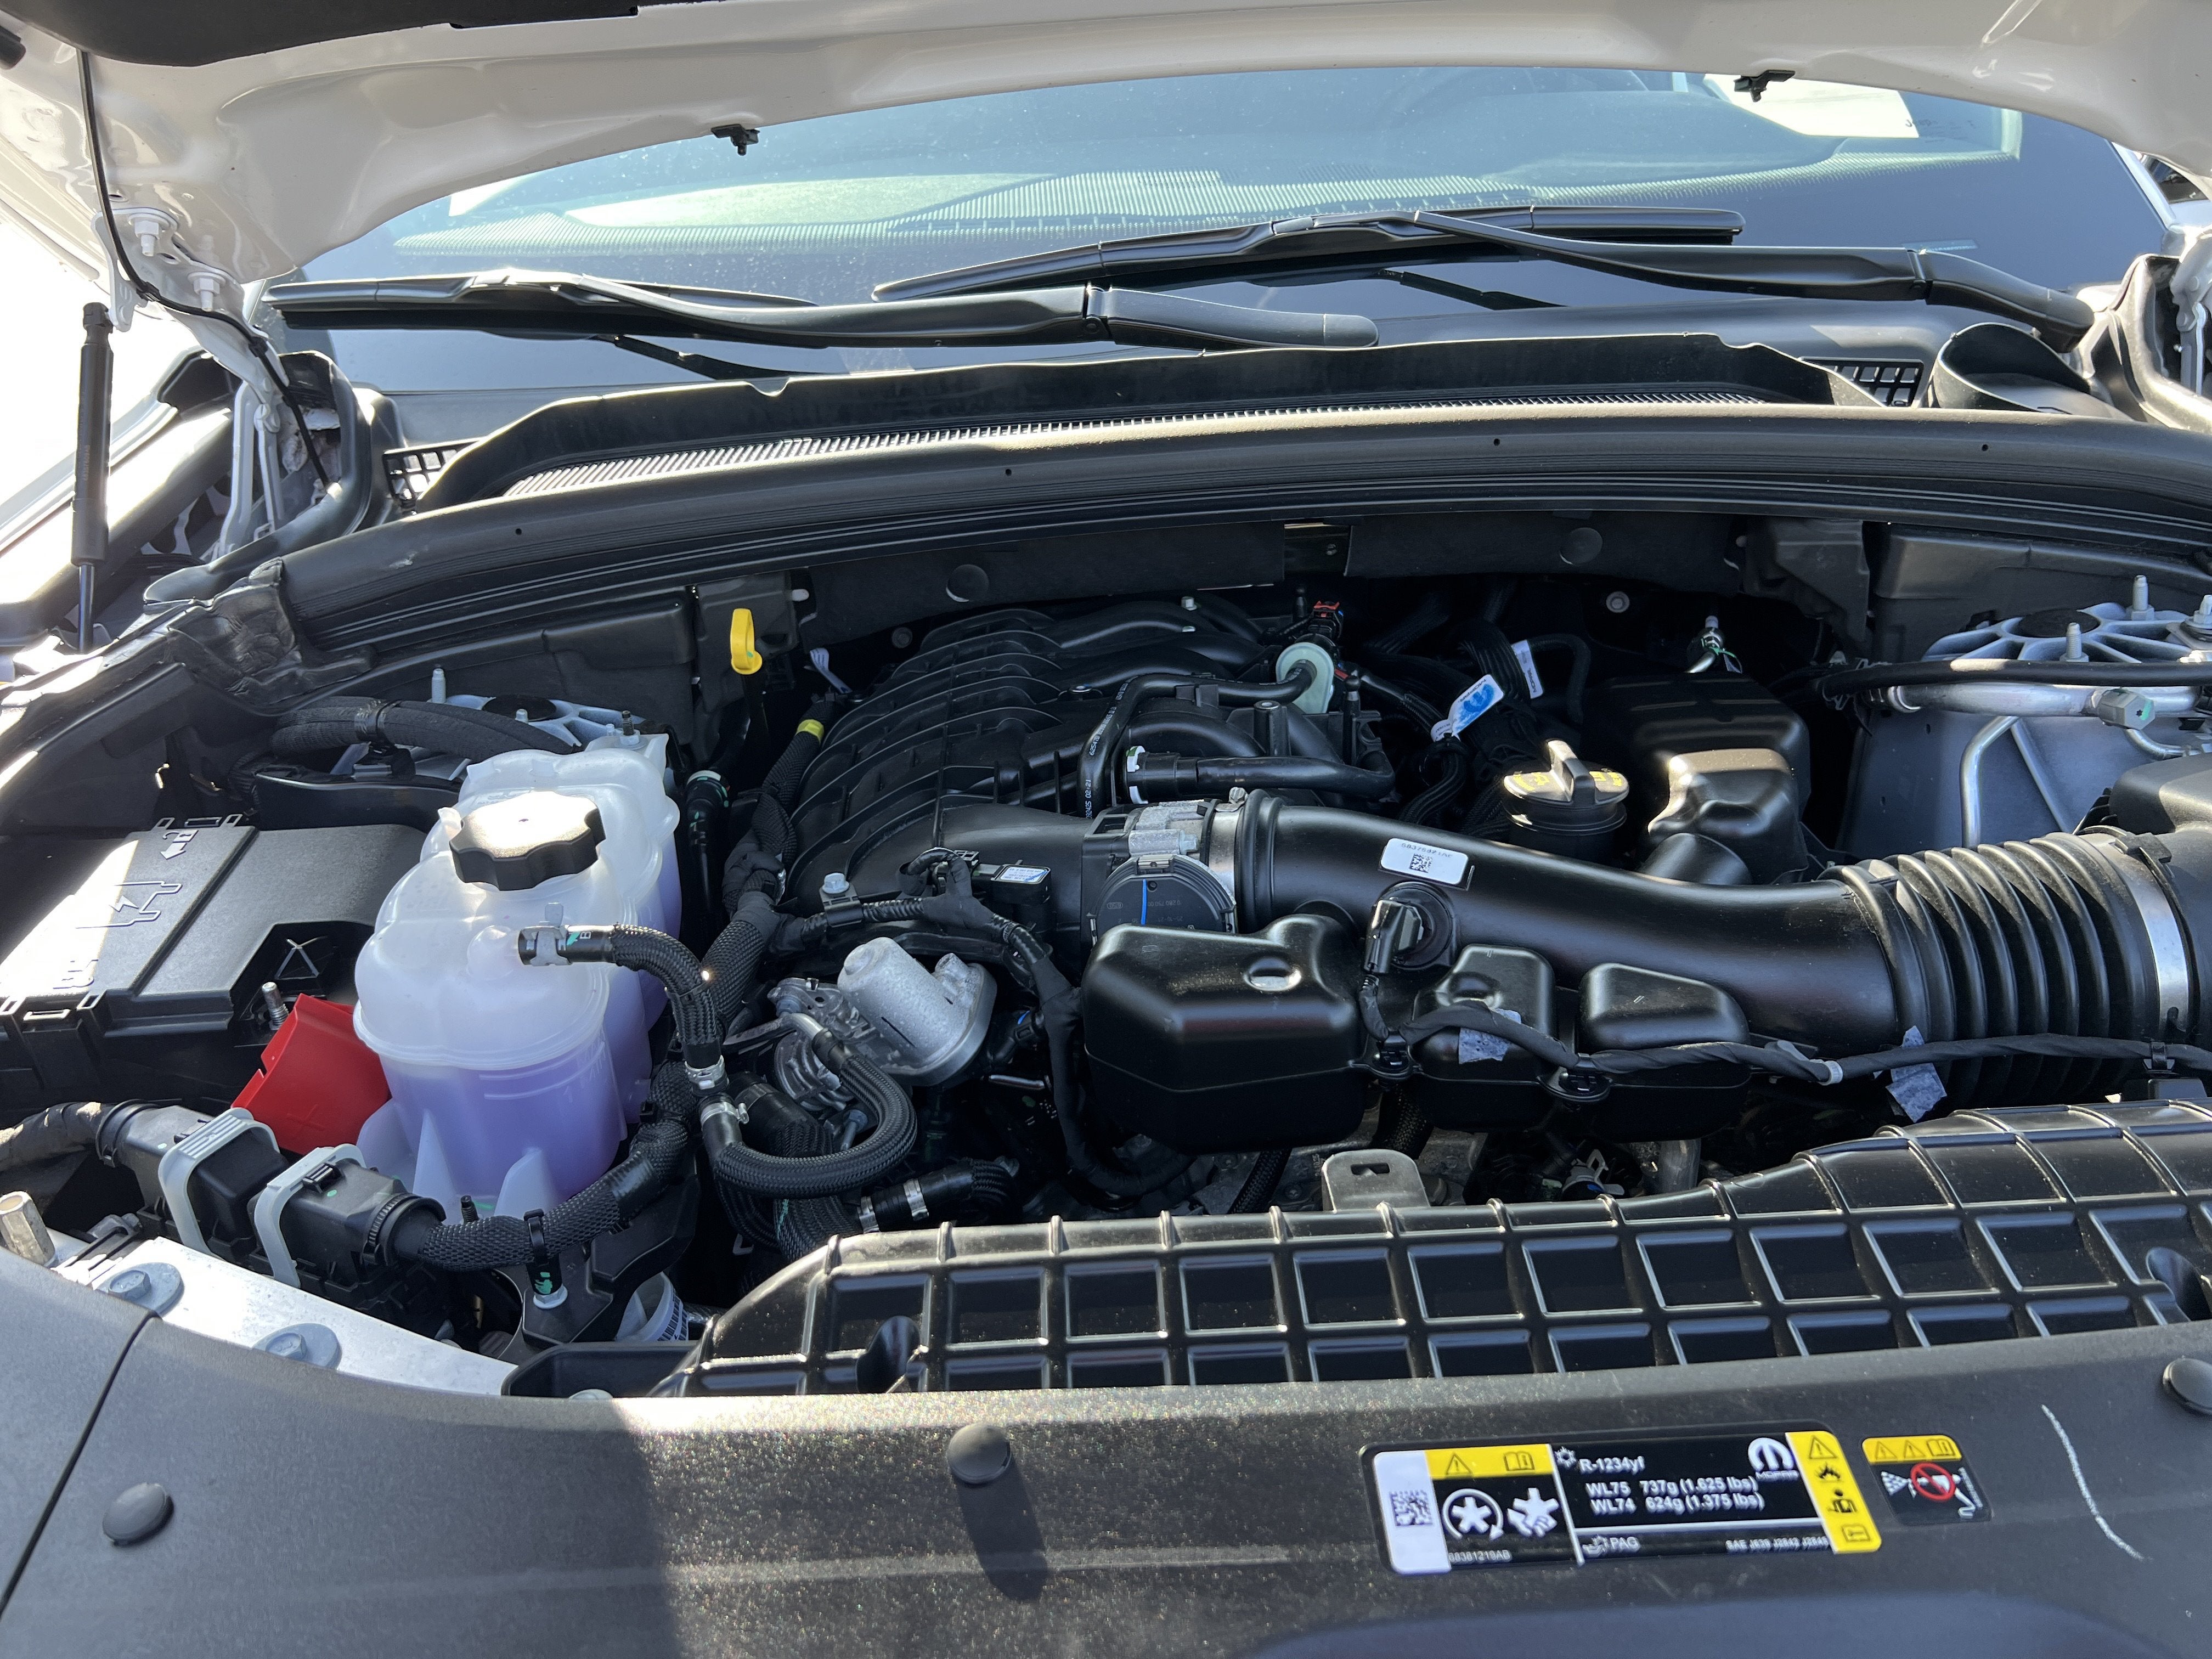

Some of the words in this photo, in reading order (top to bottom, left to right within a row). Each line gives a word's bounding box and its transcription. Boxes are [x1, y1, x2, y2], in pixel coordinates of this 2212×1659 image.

[1578, 1455, 1645, 1475] R-1234yf
[1585, 1481, 1632, 1499] WL75
[1639, 1479, 1680, 1498] 737g
[1726, 1475, 1759, 1493] lbs)
[1590, 1497, 1637, 1515] WL74
[1645, 1496, 1686, 1516] 624g
[1733, 1491, 1765, 1511] lbs)
[1609, 1536, 1640, 1553] PAG
